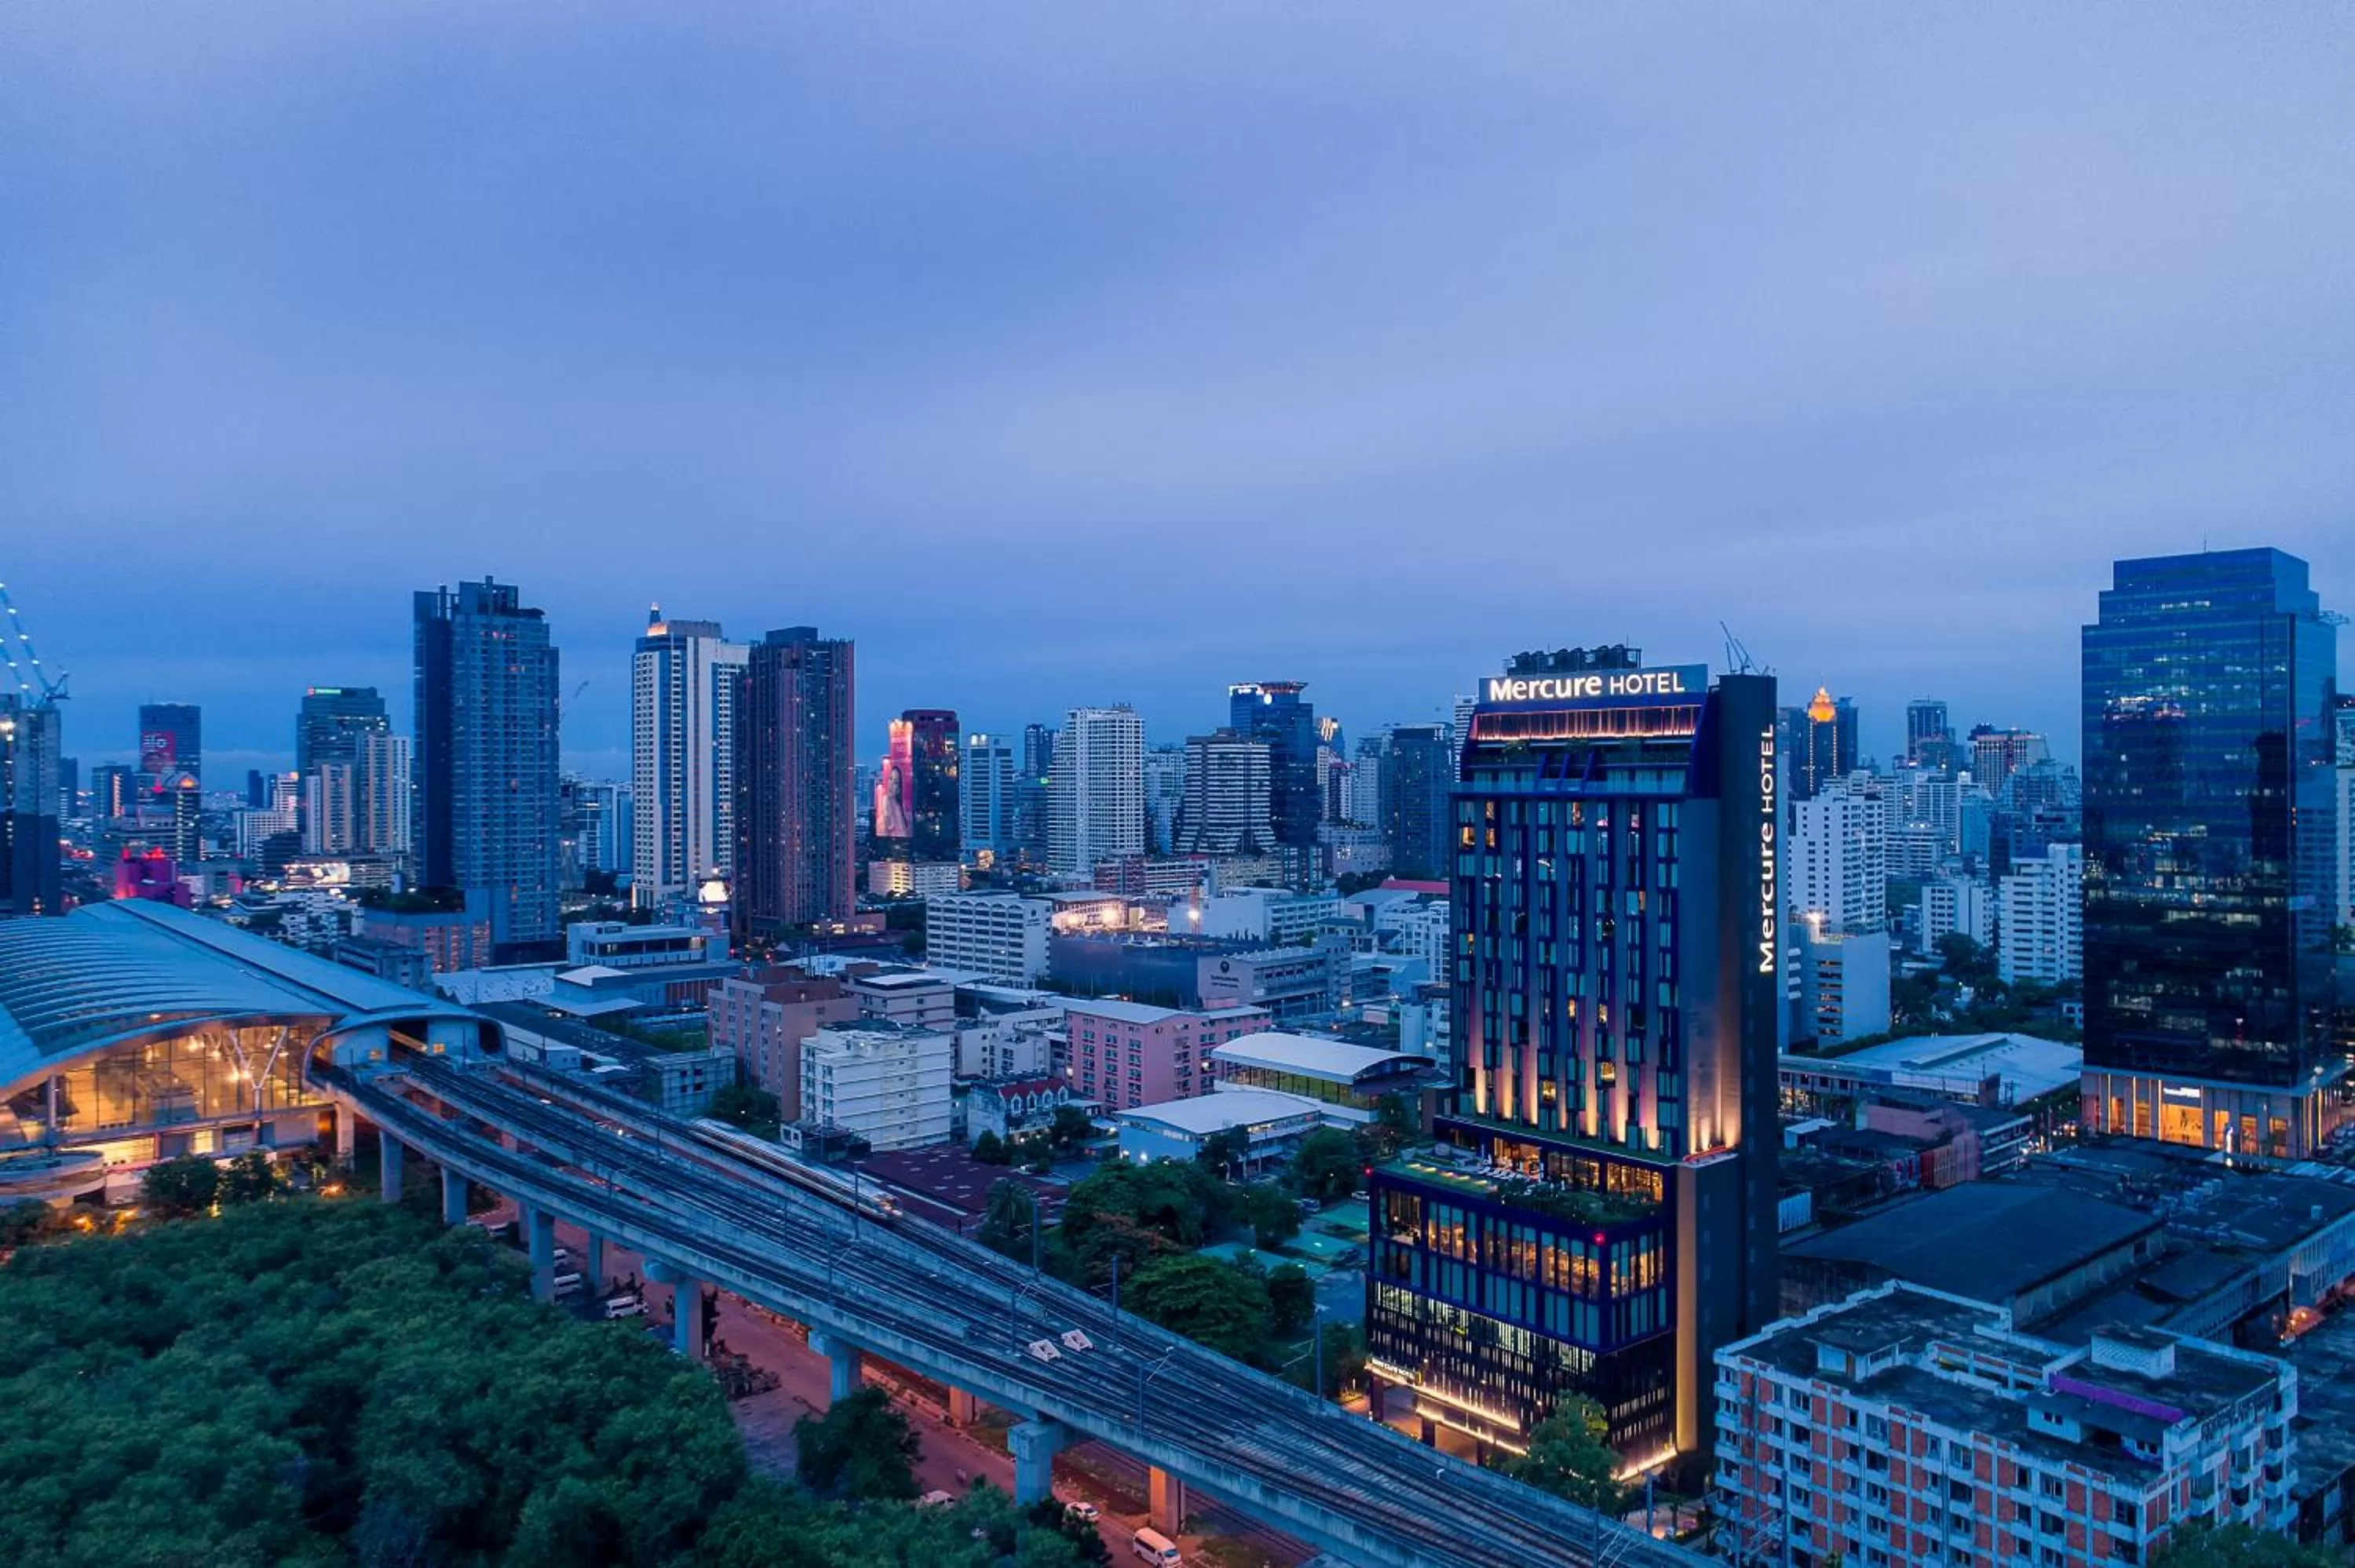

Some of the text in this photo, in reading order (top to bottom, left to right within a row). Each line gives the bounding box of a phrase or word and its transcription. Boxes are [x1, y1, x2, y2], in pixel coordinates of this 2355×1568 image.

[1489, 672, 1685, 702] Mercure HOTEL
[1759, 724, 1774, 972] Mercure HOTEL
